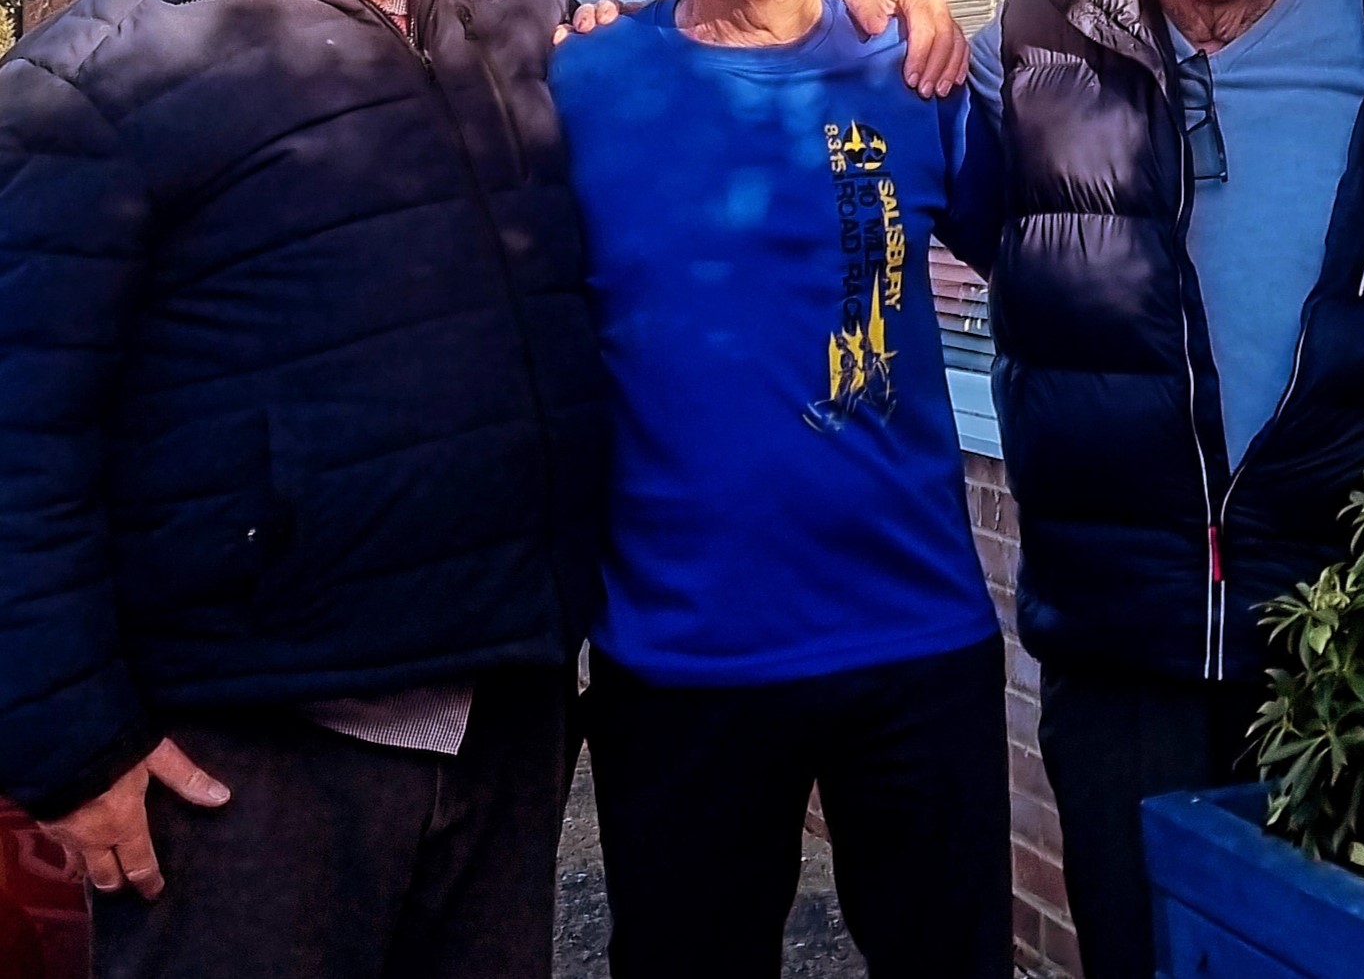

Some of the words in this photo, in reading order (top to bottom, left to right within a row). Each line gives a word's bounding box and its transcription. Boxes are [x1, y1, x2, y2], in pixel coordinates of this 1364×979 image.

[834, 181, 861, 254] ROAD
[858, 181, 877, 208] 10
[877, 179, 905, 312] SALISBURY
[840, 265, 862, 335] RACE
